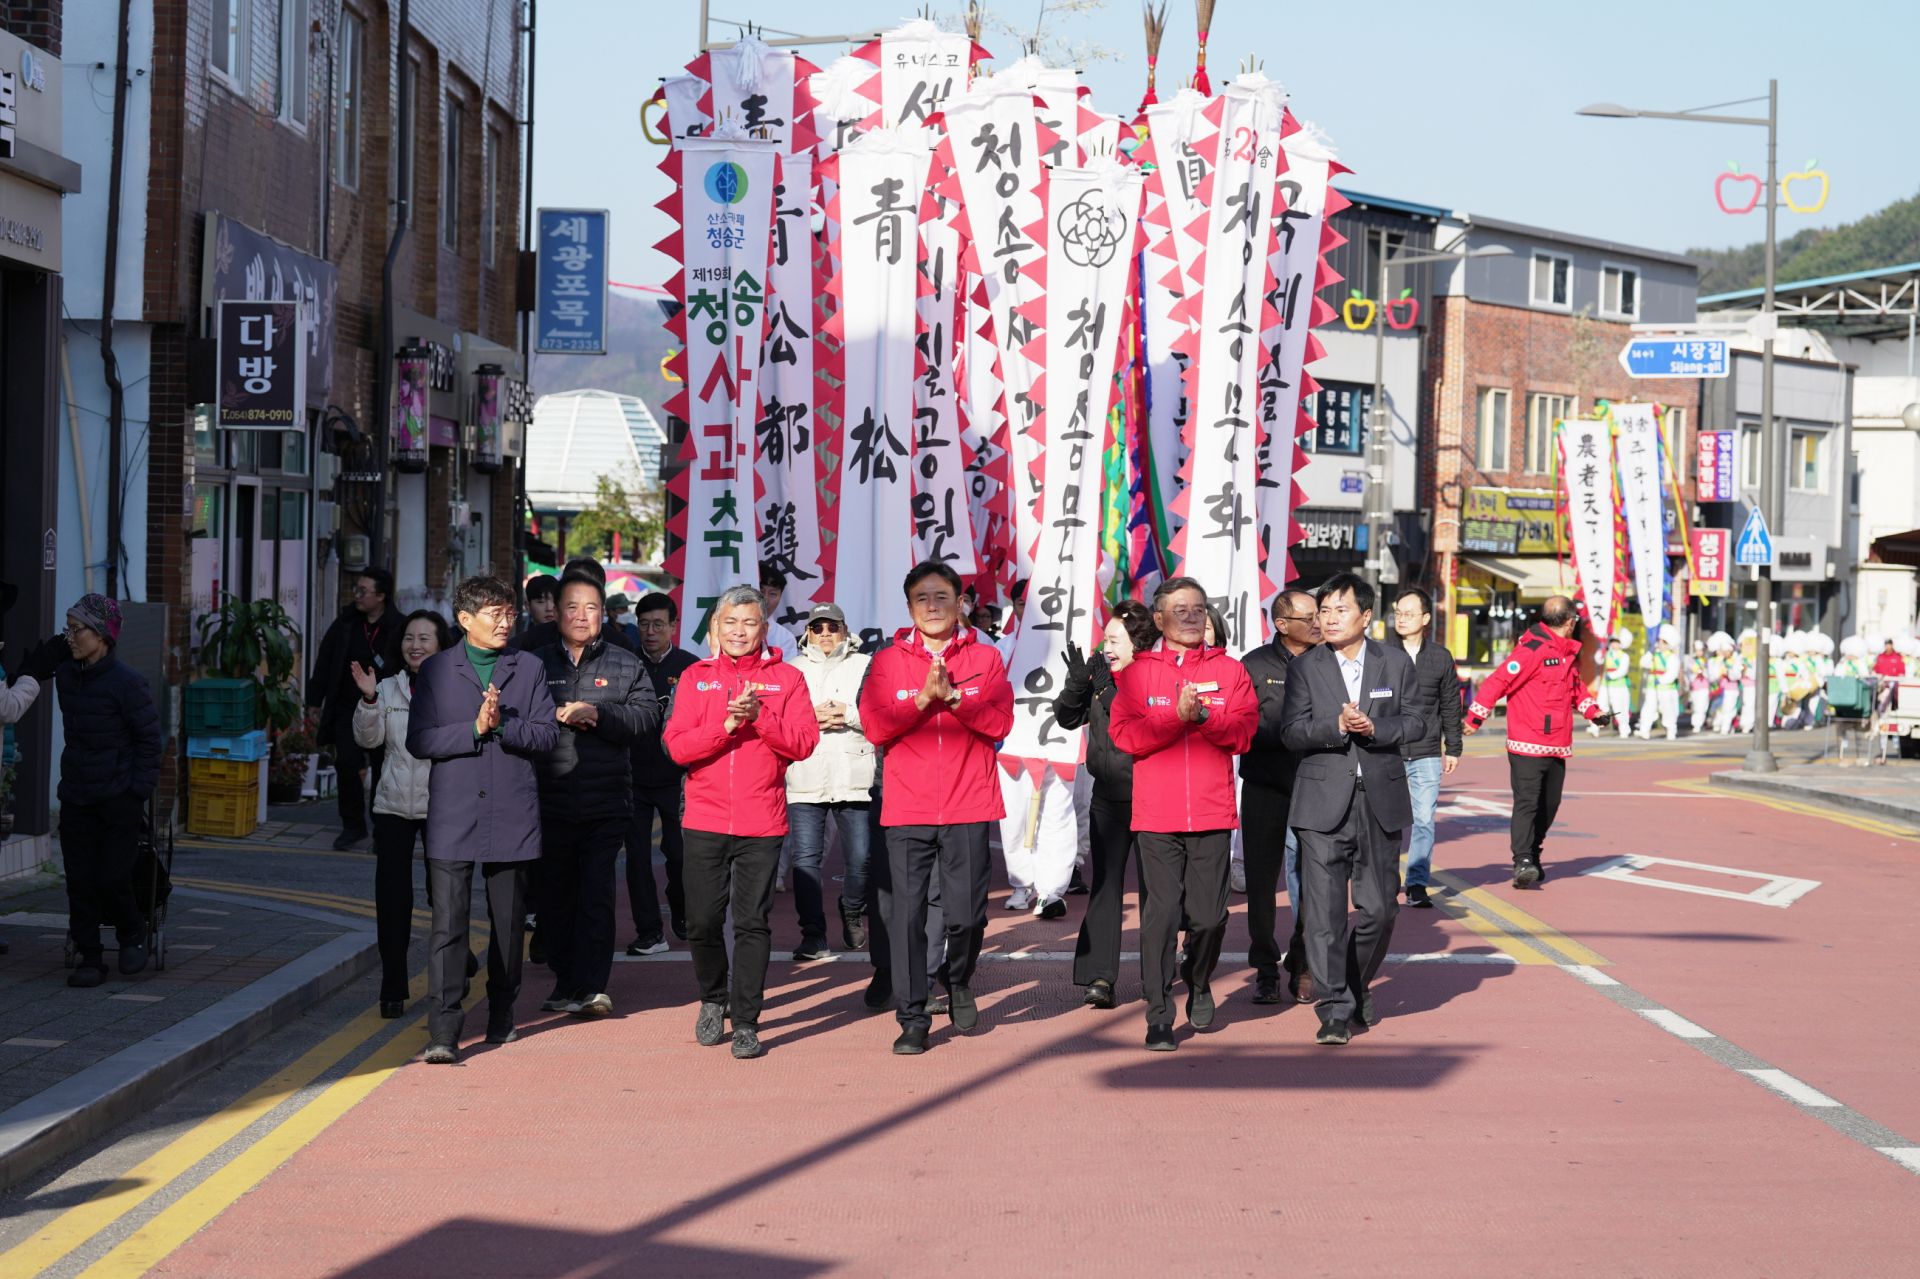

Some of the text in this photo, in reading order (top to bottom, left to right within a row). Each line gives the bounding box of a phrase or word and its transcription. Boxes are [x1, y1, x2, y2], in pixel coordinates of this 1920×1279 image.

[894, 53, 960, 69] 유네스코
[707, 212, 745, 227] 산소카페
[707, 227, 745, 249] 청송군
[549, 217, 593, 327] 세광포목
[692, 266, 732, 282] 제19회
[541, 338, 600, 350] 873-2335
[1672, 342, 1723, 361] 시장길
[238, 314, 278, 395] 다방
[1670, 361, 1723, 374] Sijang-gil
[1015, 297, 1106, 746] 청송문화원
